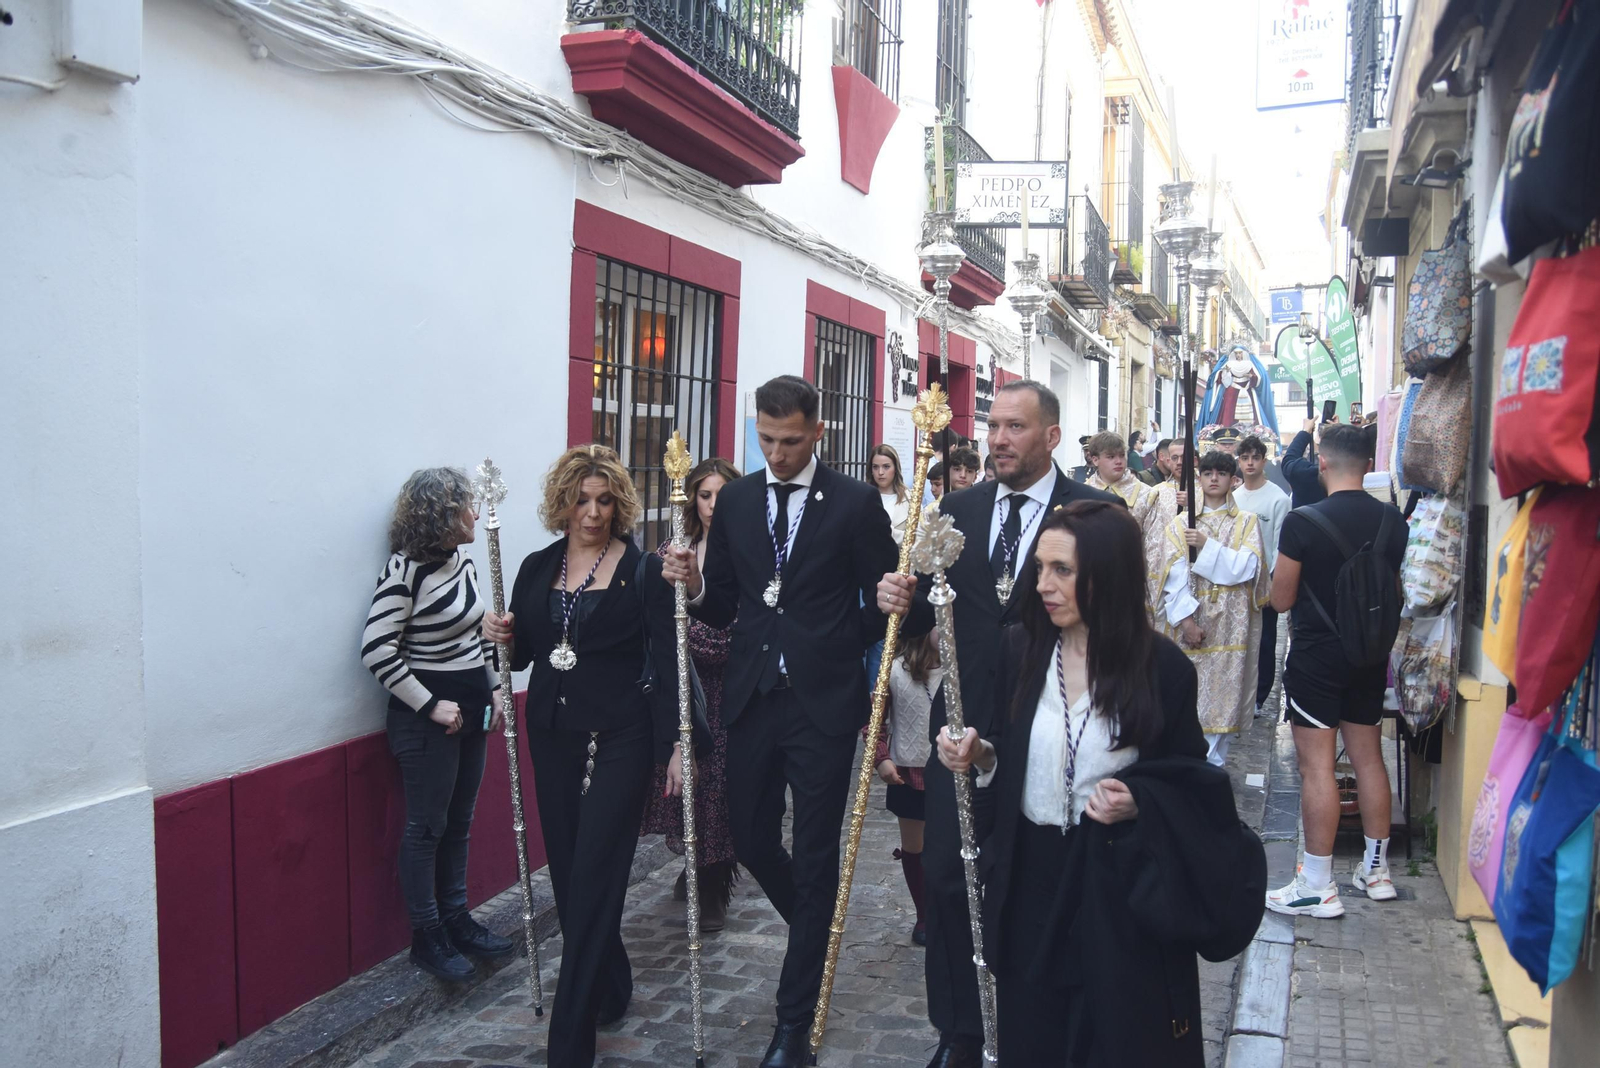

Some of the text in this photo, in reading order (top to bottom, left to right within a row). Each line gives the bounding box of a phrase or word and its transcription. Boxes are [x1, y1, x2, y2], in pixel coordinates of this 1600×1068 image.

[980, 177, 1042, 192] PEDRO
[1292, 355, 1325, 372] expess
[1314, 380, 1339, 394] NUEVO
[1314, 389, 1342, 403] SUPER
